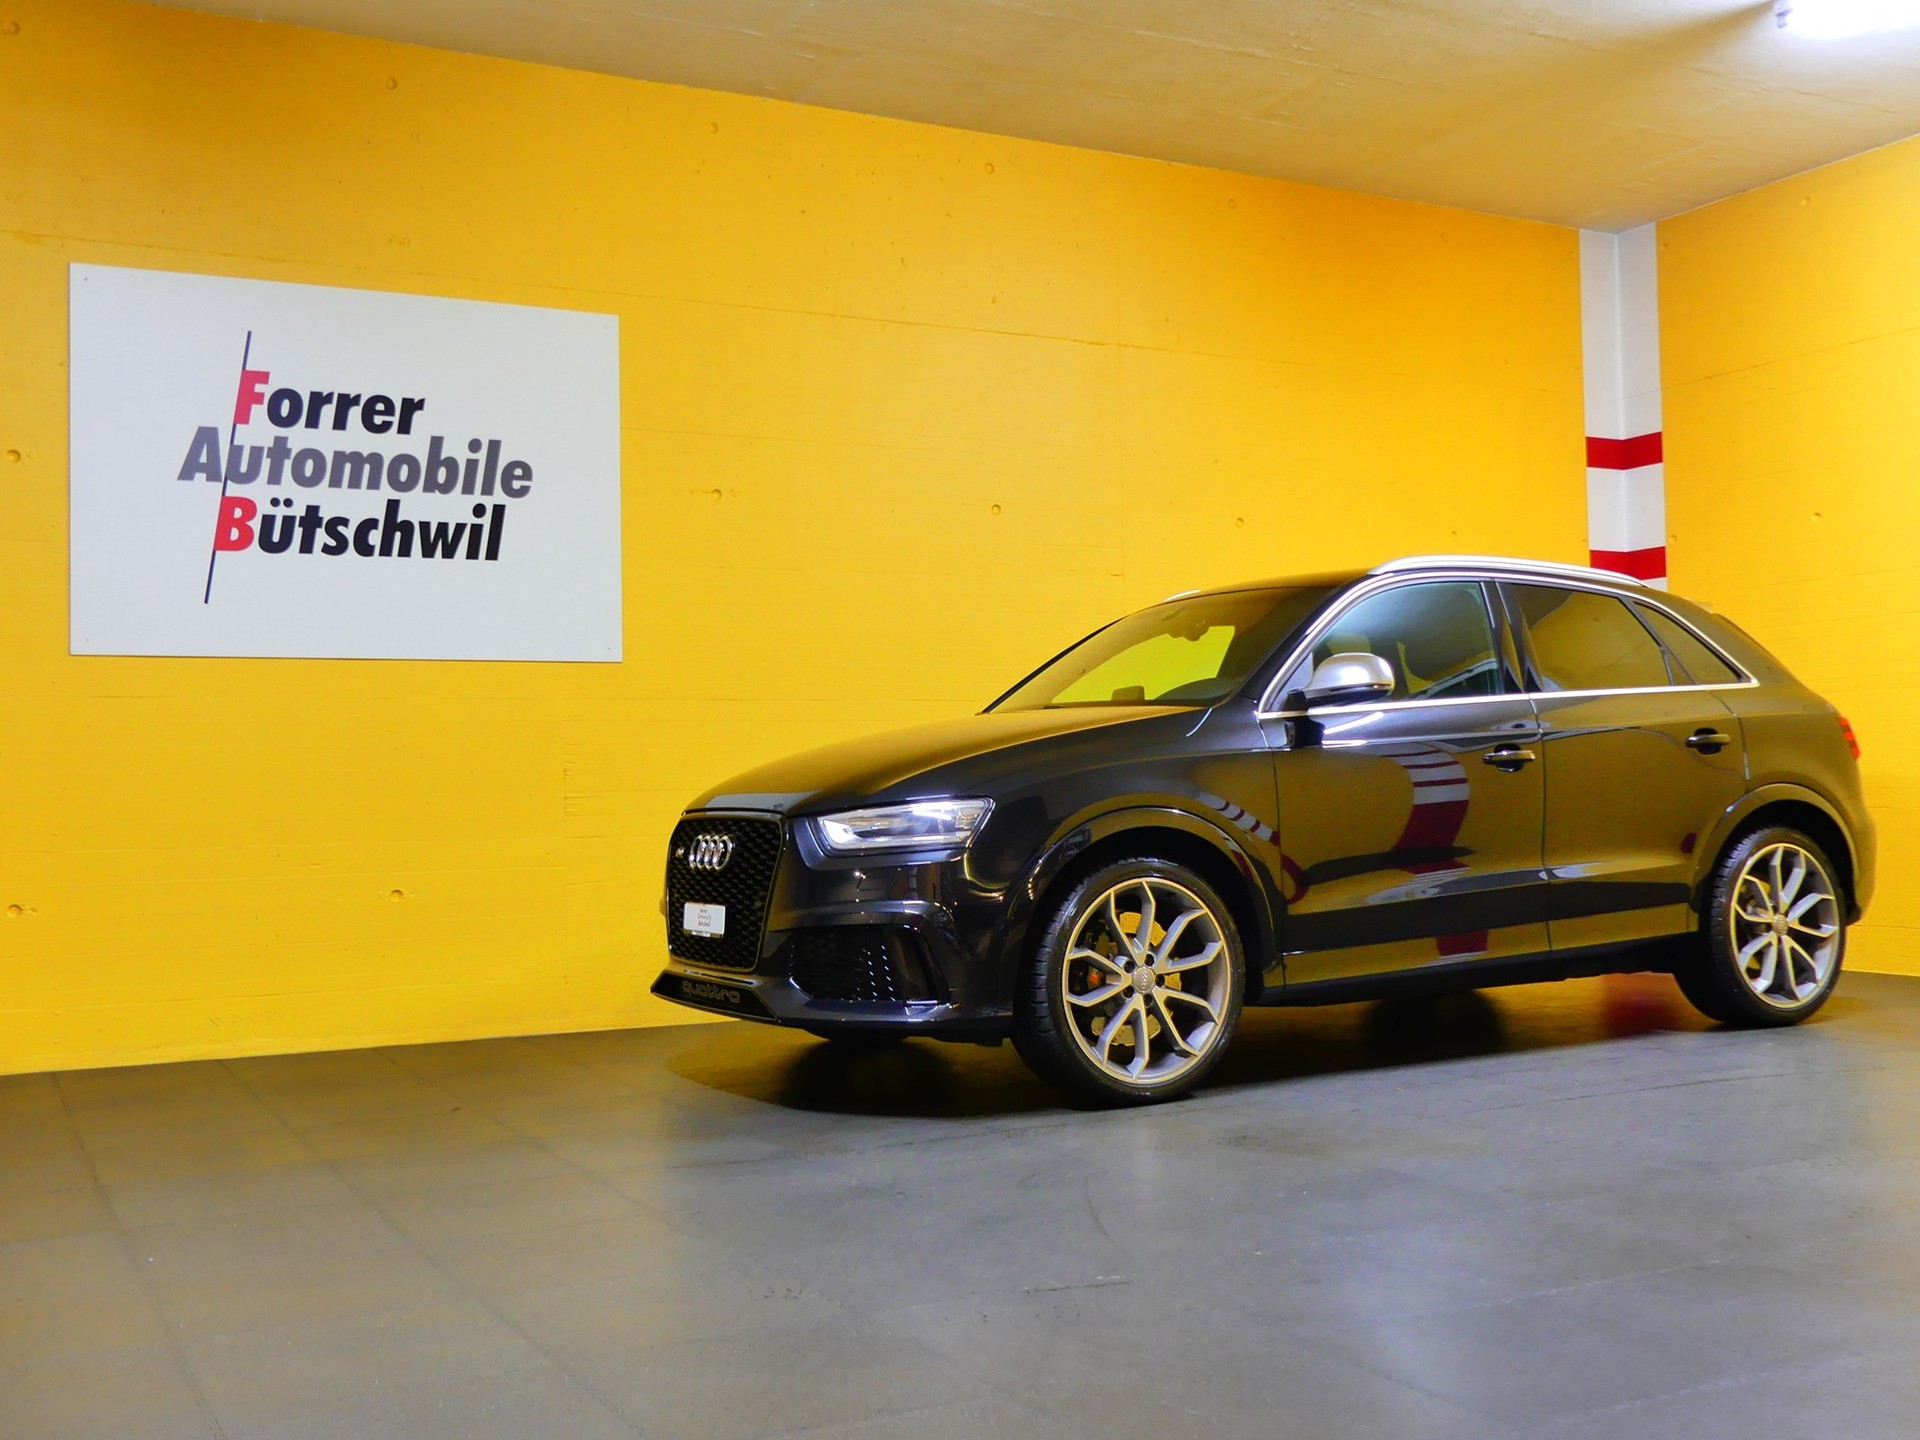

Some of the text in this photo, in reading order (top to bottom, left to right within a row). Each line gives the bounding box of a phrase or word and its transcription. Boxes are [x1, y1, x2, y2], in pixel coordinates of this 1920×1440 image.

[234, 369, 426, 436] Forrer
[176, 426, 534, 499] Automobile
[214, 495, 507, 562] Bütschwil
[681, 981, 741, 1003] quattro
